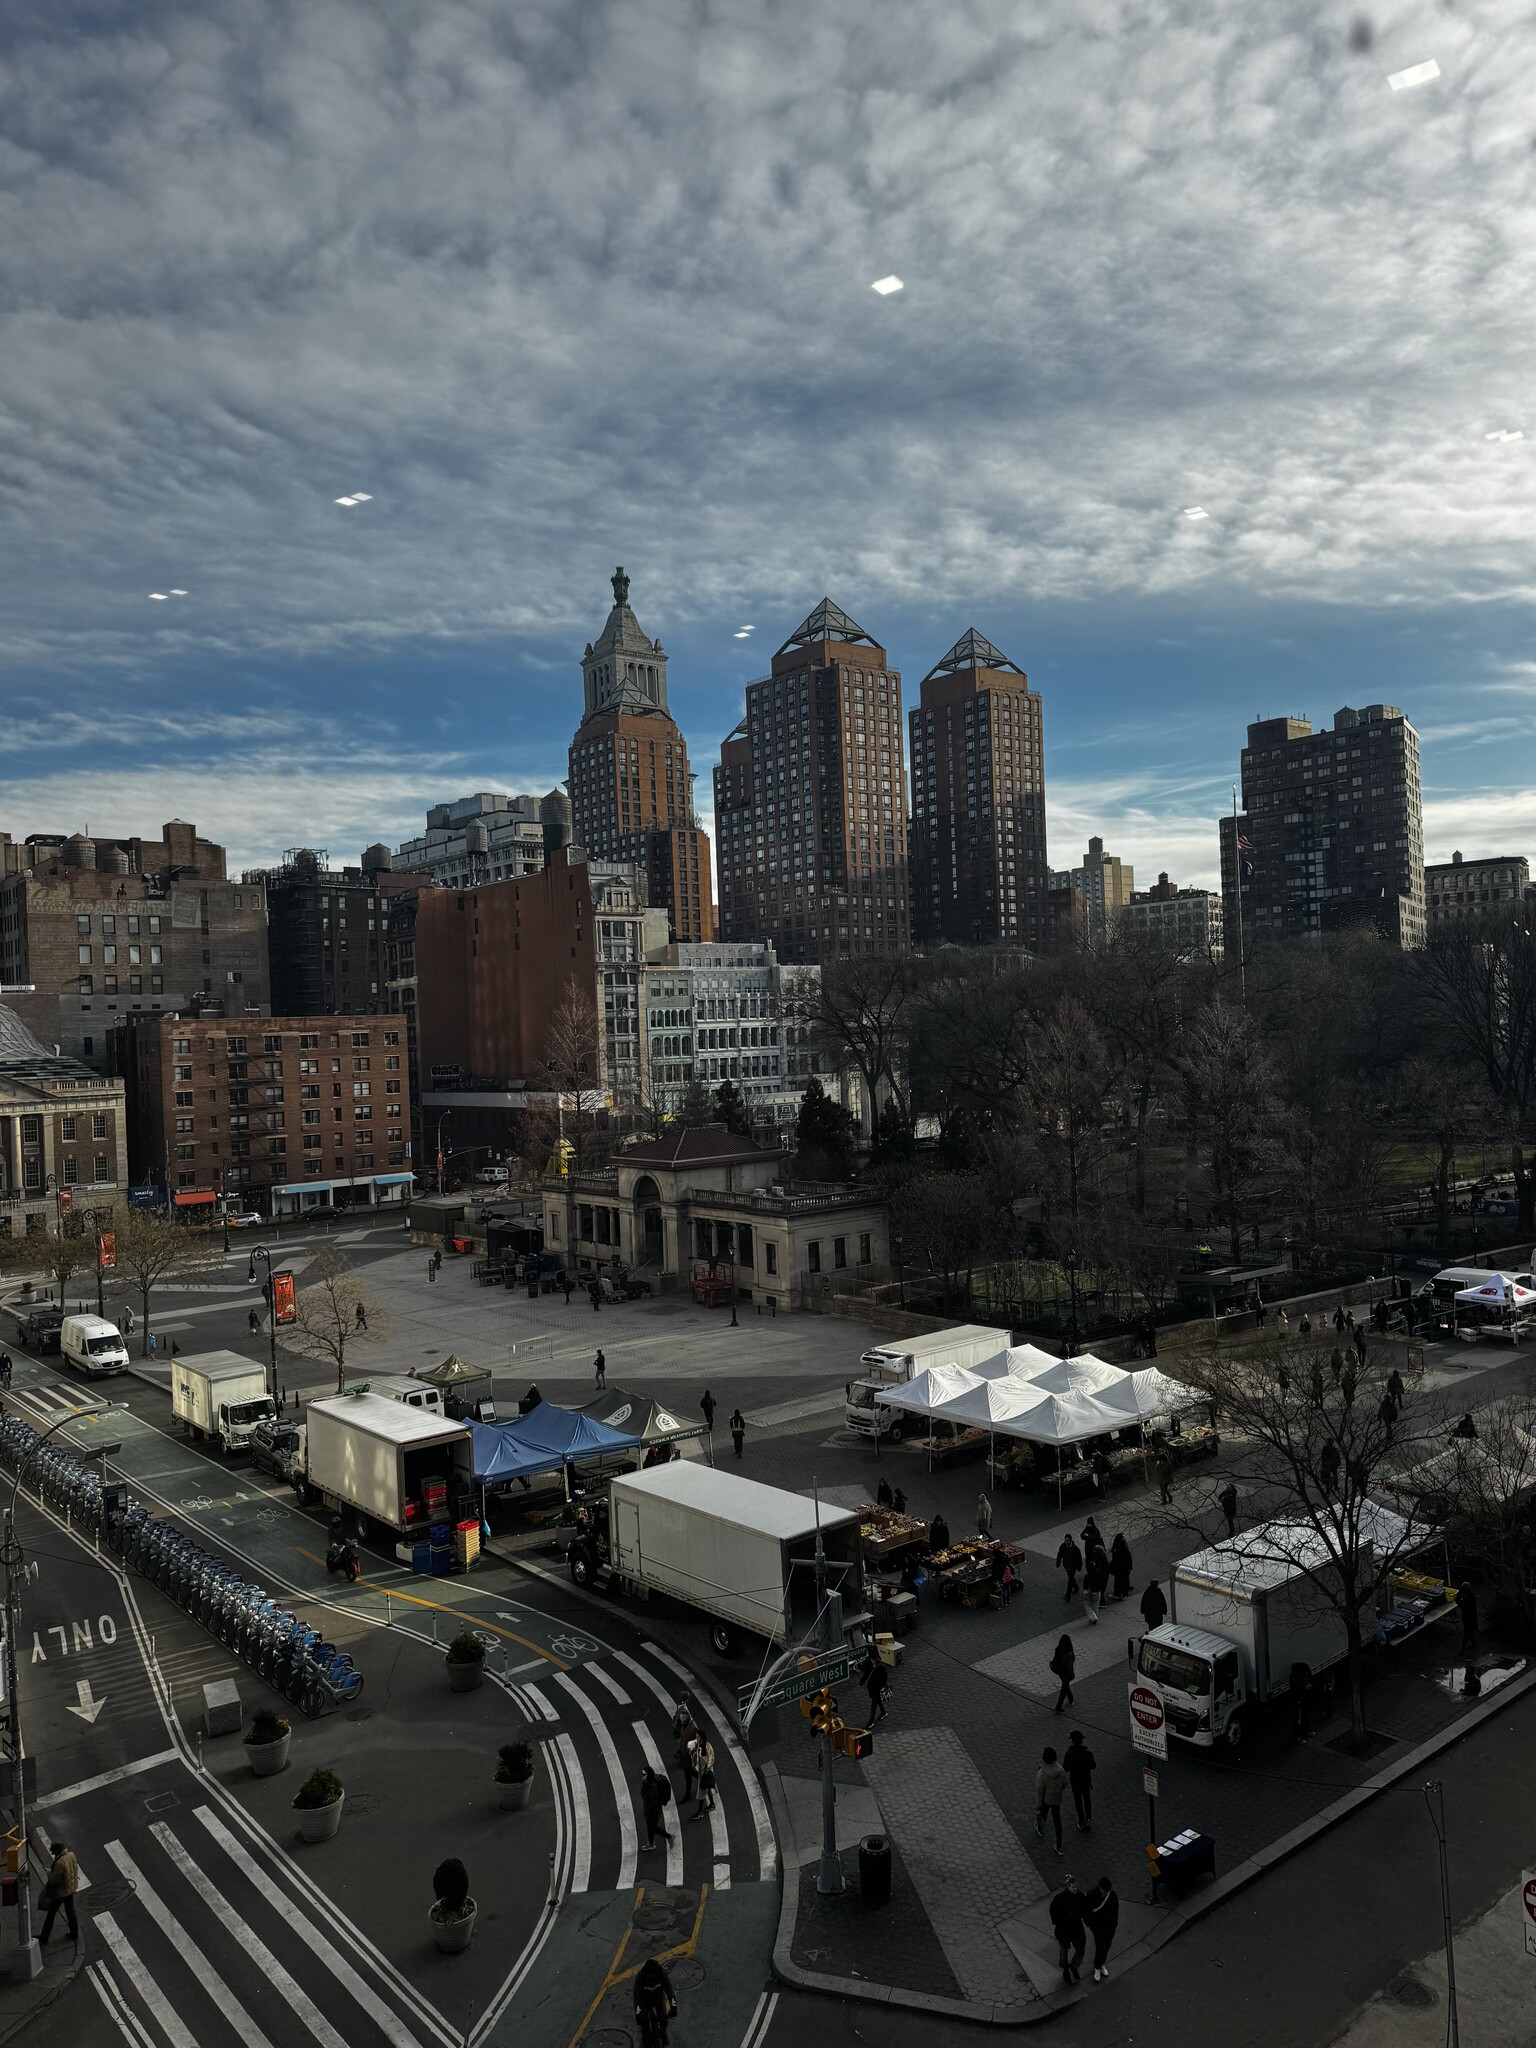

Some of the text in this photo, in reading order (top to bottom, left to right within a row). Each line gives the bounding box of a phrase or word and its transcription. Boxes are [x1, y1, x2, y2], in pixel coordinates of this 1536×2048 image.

[31, 1614, 117, 1664] ONLY
[780, 1664, 844, 1700] Square West
[1134, 1692, 1144, 1701] DO
[1144, 1696, 1158, 1707] NOT
[1136, 1711, 1158, 1725] ENTER
[1134, 1734, 1164, 1749] AUTHORIZED
[1139, 1729, 1158, 1739] EXCEPT
